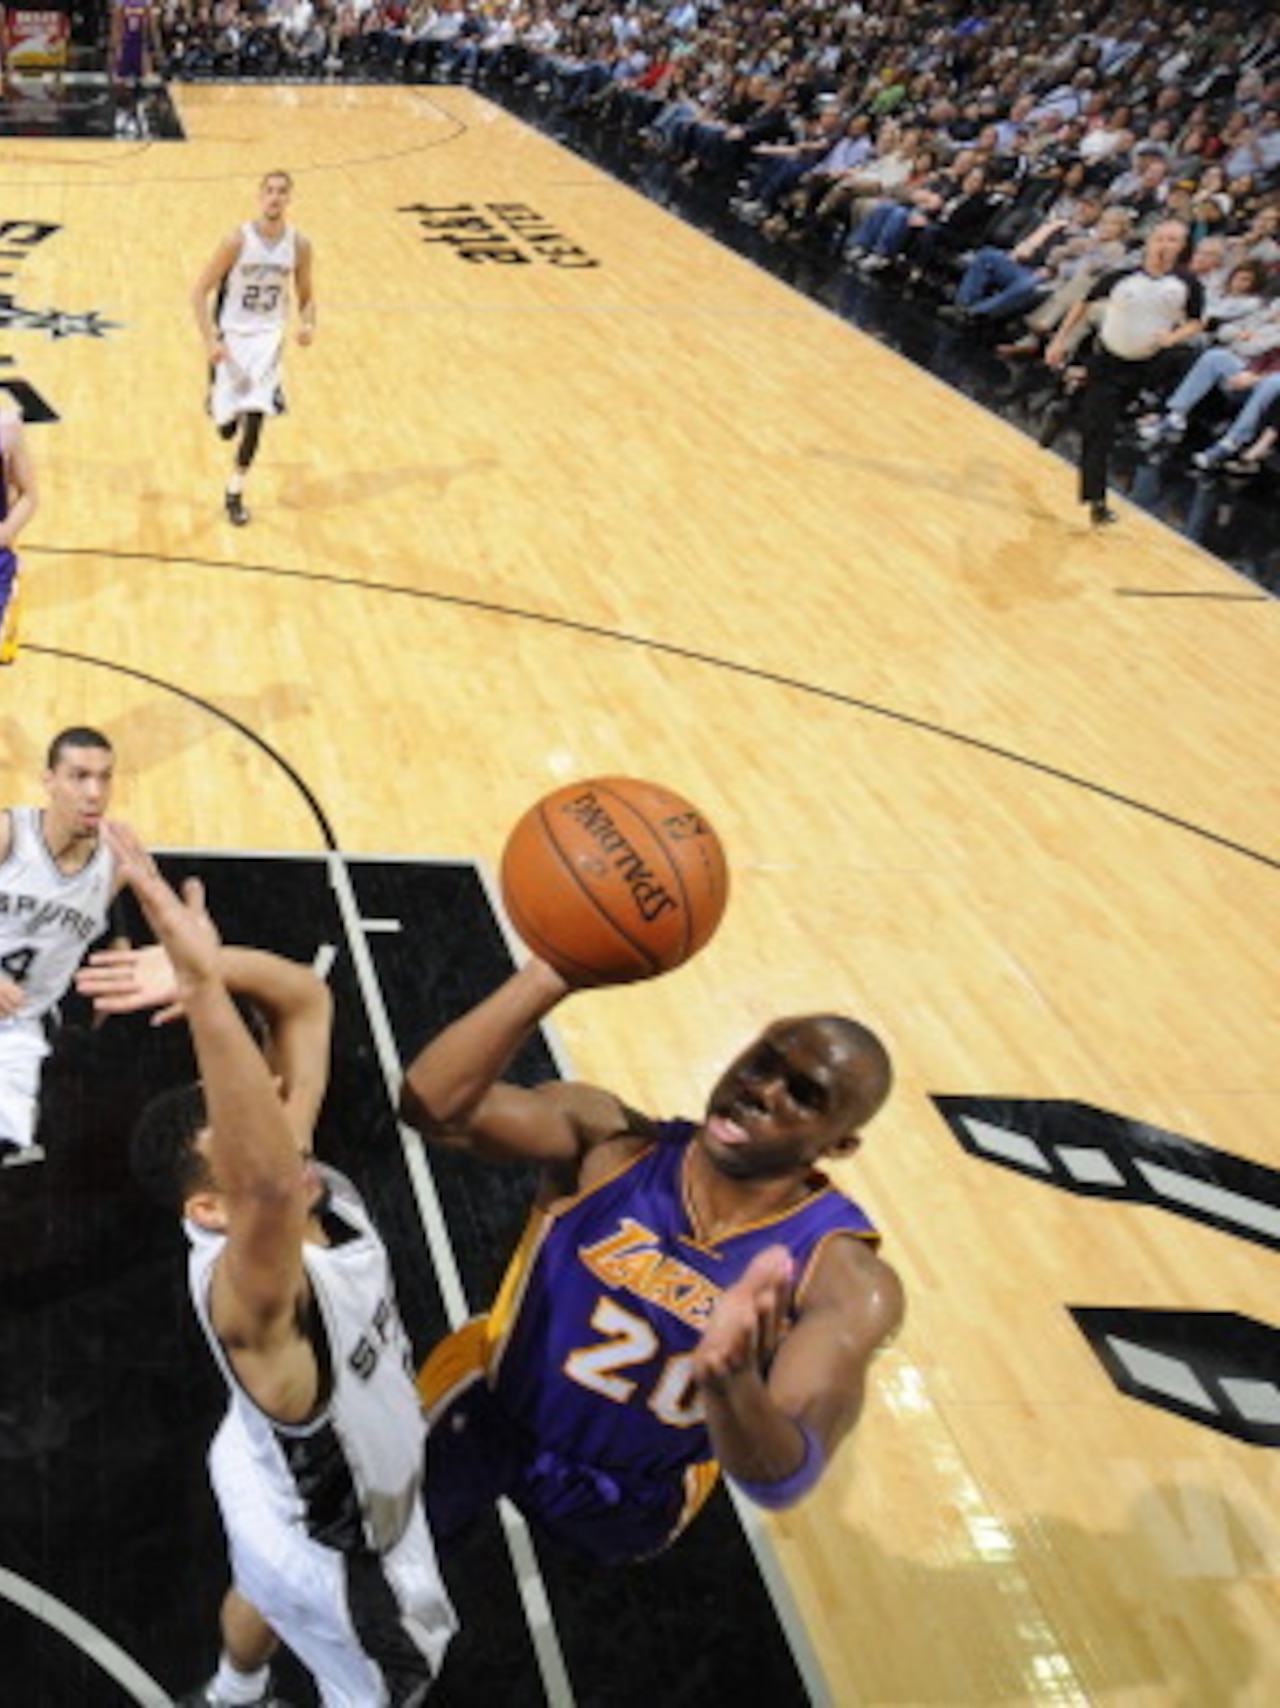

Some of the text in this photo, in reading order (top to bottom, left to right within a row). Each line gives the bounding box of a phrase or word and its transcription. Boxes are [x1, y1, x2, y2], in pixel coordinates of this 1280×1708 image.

[241, 284, 282, 312] 23
[571, 791, 679, 922] SPALDING
[0, 946, 38, 982] 4
[577, 1217, 724, 1332] LAKE
